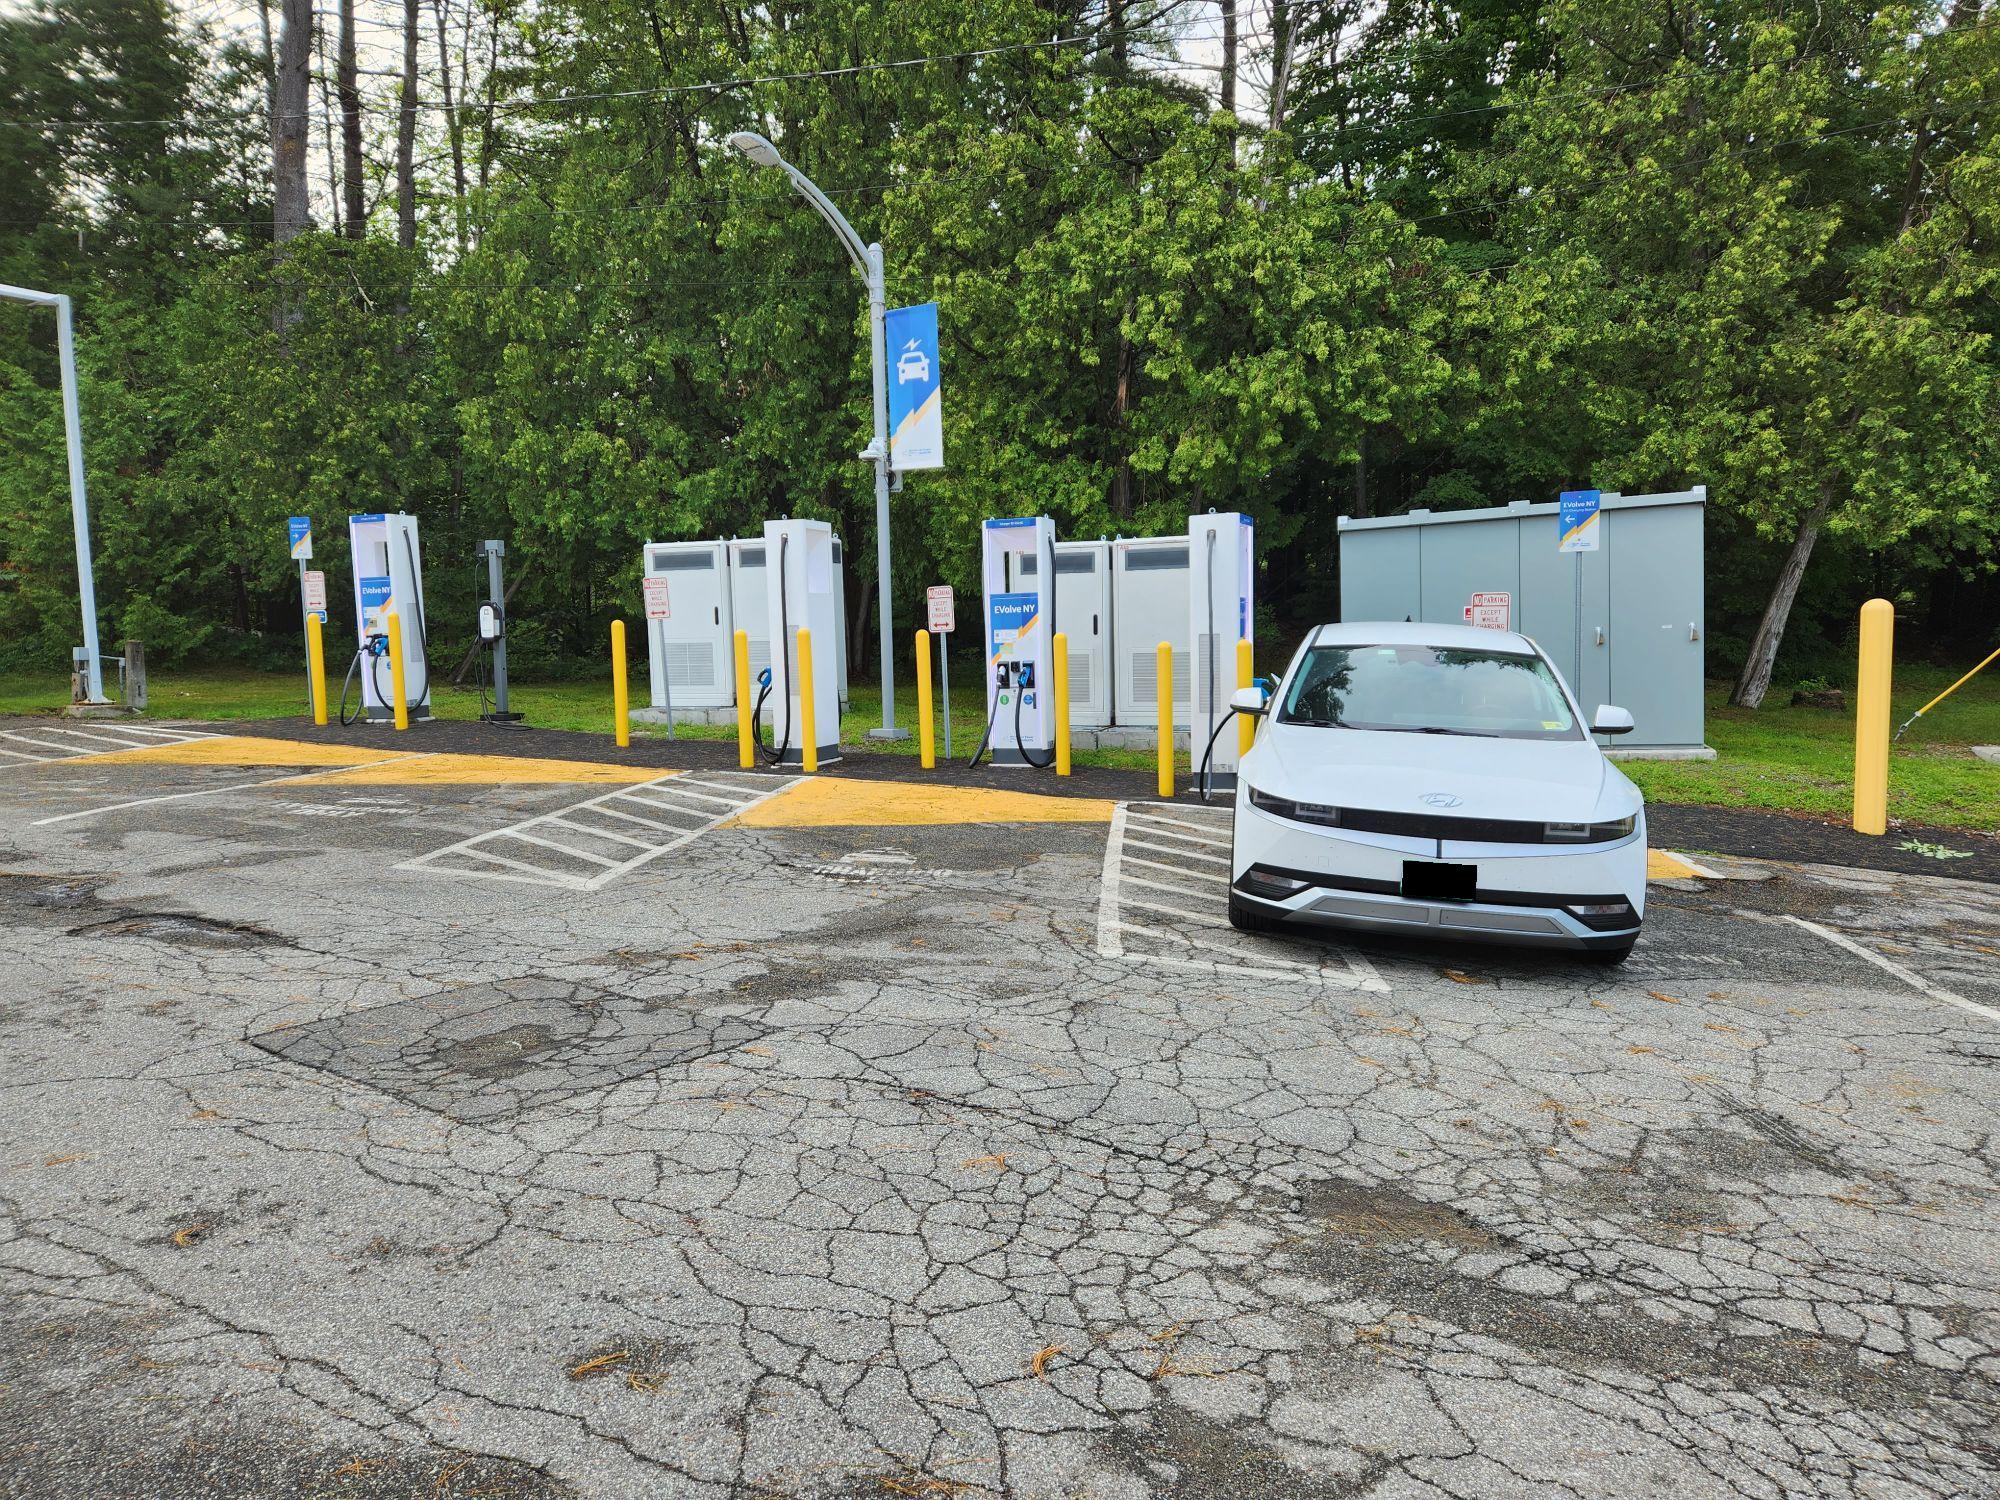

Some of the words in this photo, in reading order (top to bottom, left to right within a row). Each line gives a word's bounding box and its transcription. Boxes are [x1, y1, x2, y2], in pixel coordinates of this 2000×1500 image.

[362, 586, 382, 595] EVolve
[382, 586, 391, 594] NY
[1483, 596, 1508, 604] PARKING
[994, 604, 1022, 614] EVolve
[1022, 604, 1036, 613] NY
